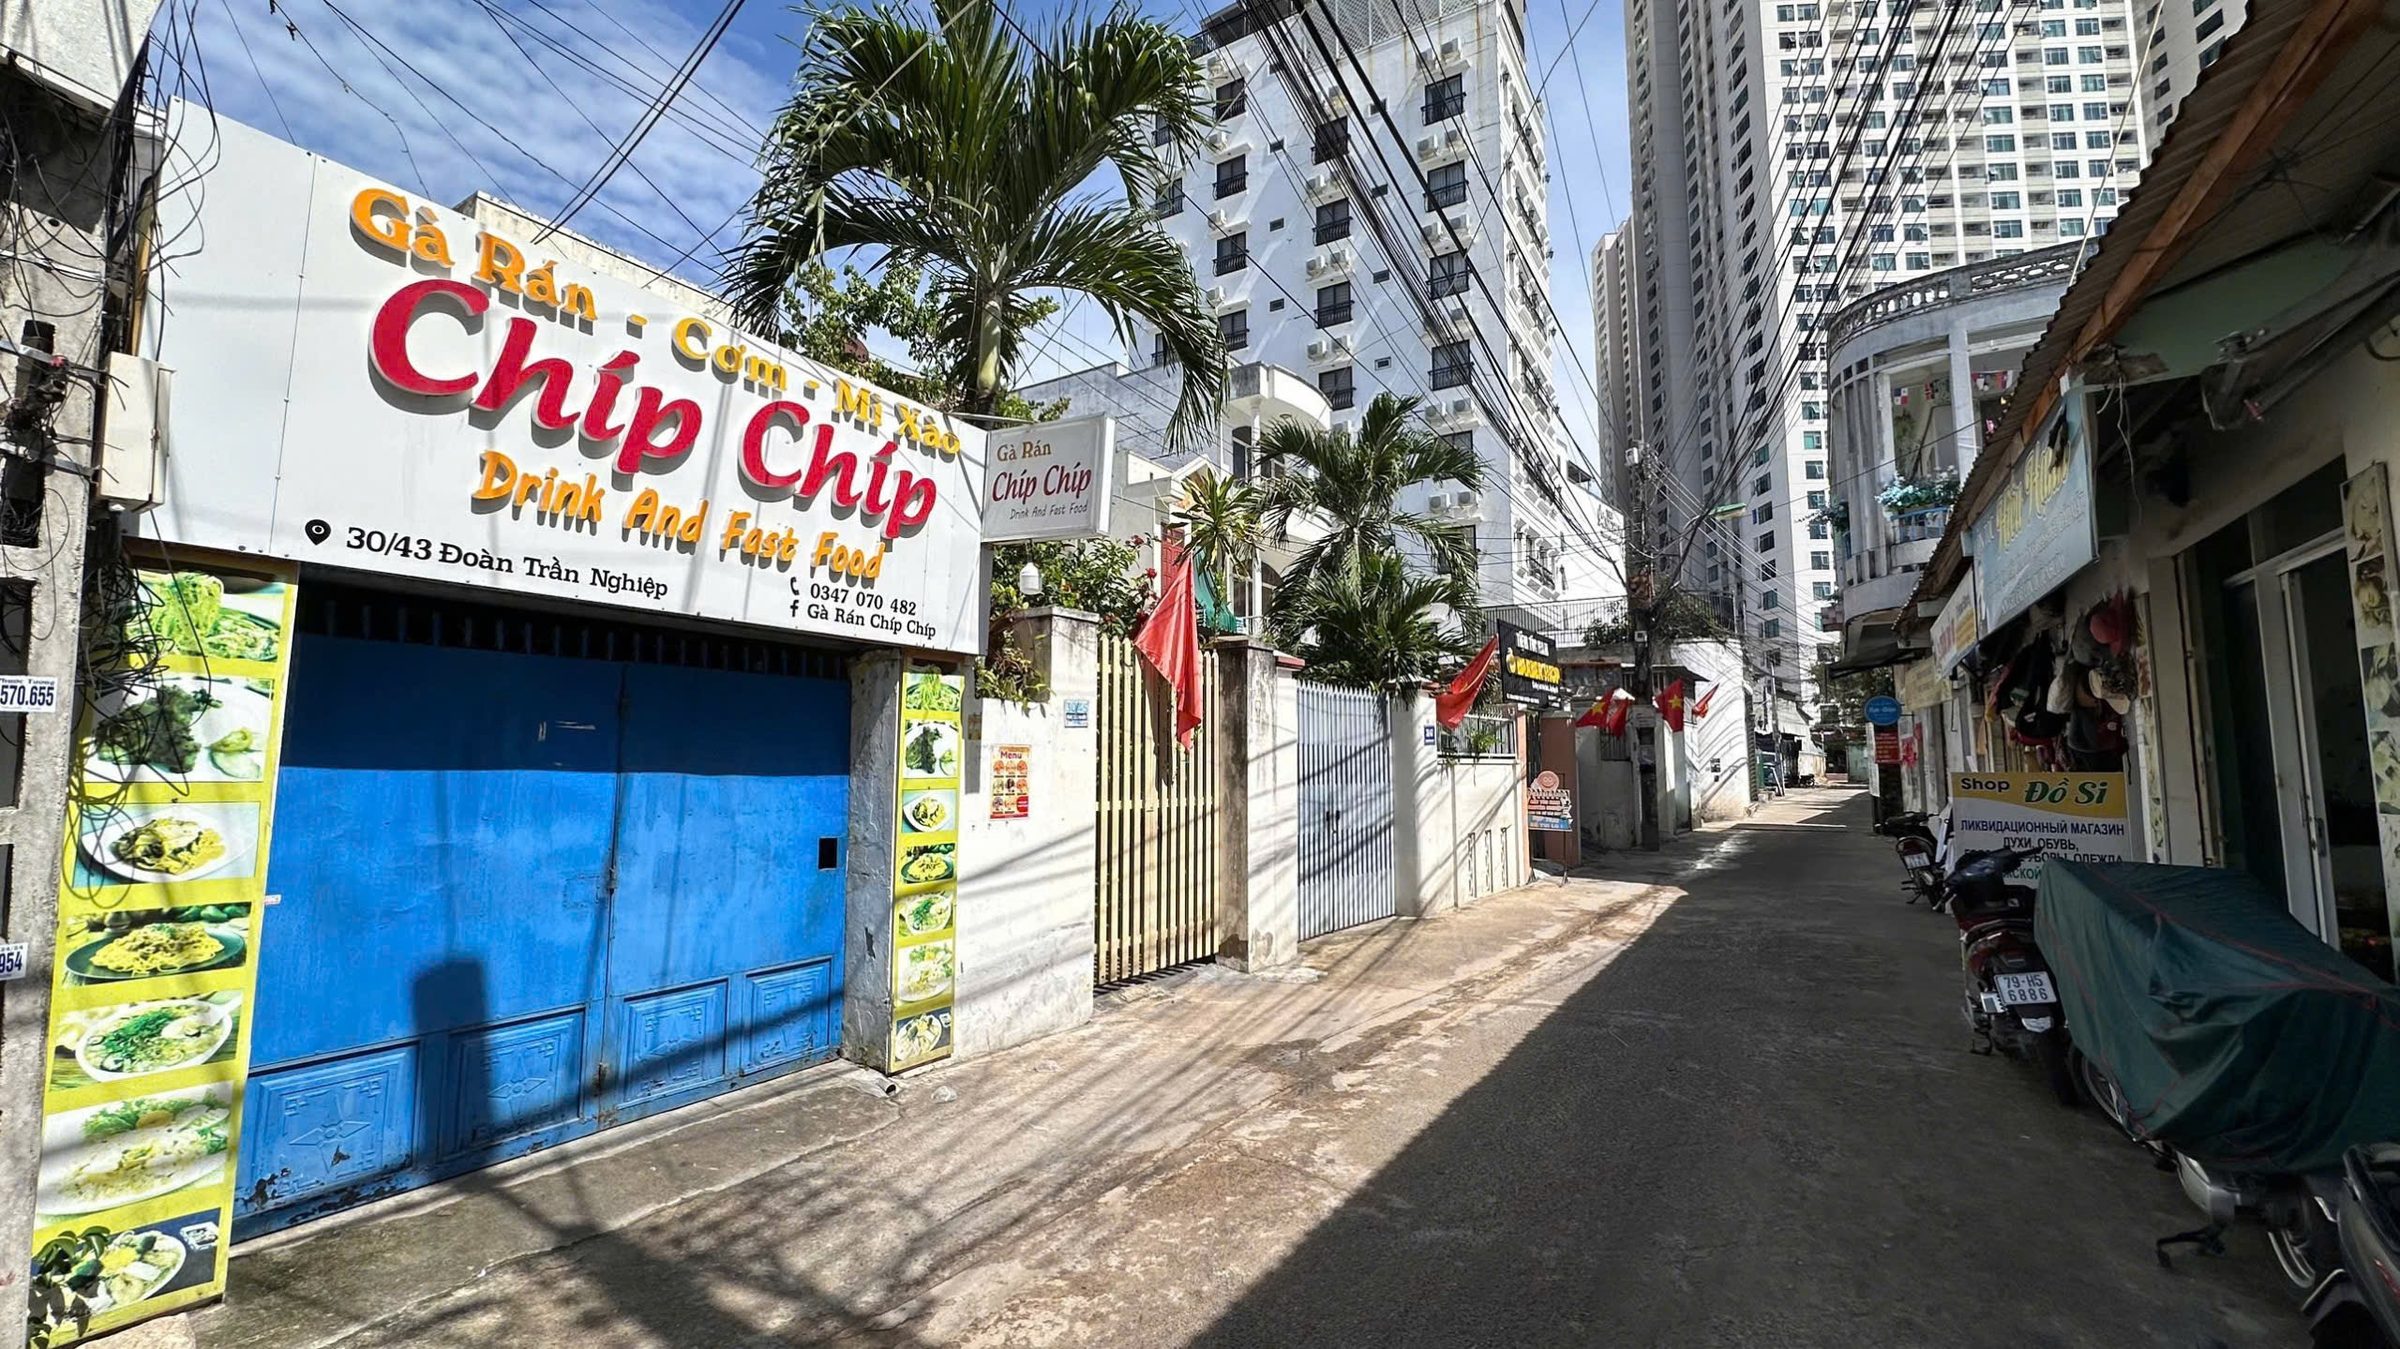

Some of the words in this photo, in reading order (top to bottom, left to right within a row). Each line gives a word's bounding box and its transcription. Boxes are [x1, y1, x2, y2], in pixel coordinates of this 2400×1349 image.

[350, 188, 456, 269] Gà
[475, 231, 598, 322] Rán
[672, 317, 788, 392] Cơm
[834, 378, 883, 427] Mì
[895, 402, 960, 454] Xào
[369, 279, 703, 473] Chíp
[739, 400, 936, 539] Chíp
[996, 444, 1017, 462] Gà
[1021, 440, 1052, 459] Rán
[991, 468, 1038, 505] Chíp
[1043, 461, 1092, 499] Chíp
[474, 449, 605, 522] Drink
[622, 486, 709, 543] And
[723, 510, 800, 560] Fast
[814, 531, 886, 578] Food
[1009, 508, 1029, 520] Drink
[1032, 506, 1046, 517] And
[1049, 504, 1066, 516] Fast
[1069, 499, 1089, 514] Food
[346, 527, 431, 560] 30/43
[438, 542, 514, 573] Đoàn
[523, 556, 580, 584] Trần
[589, 567, 669, 599] Nghiệp
[810, 583, 849, 604] 0347
[856, 591, 883, 610] 070
[890, 599, 917, 616] 482
[807, 603, 829, 621] Gà
[834, 608, 865, 626] Rán
[870, 613, 903, 635] Chíp
[906, 619, 936, 640] Chíp
[1000, 751, 1022, 760] Menu
[1961, 777, 2010, 793] Shop
[2024, 777, 2070, 804] Đồ
[2074, 781, 2109, 805] Si
[1960, 819, 2067, 834] ЛИКВИДАЦИОННЫЙ
[2070, 823, 2125, 836] МАГАЗИН
[2037, 838, 2079, 851] ОБУВЬ,
[2004, 974, 2043, 988] 79-H5
[2008, 988, 2048, 1001] 6886
